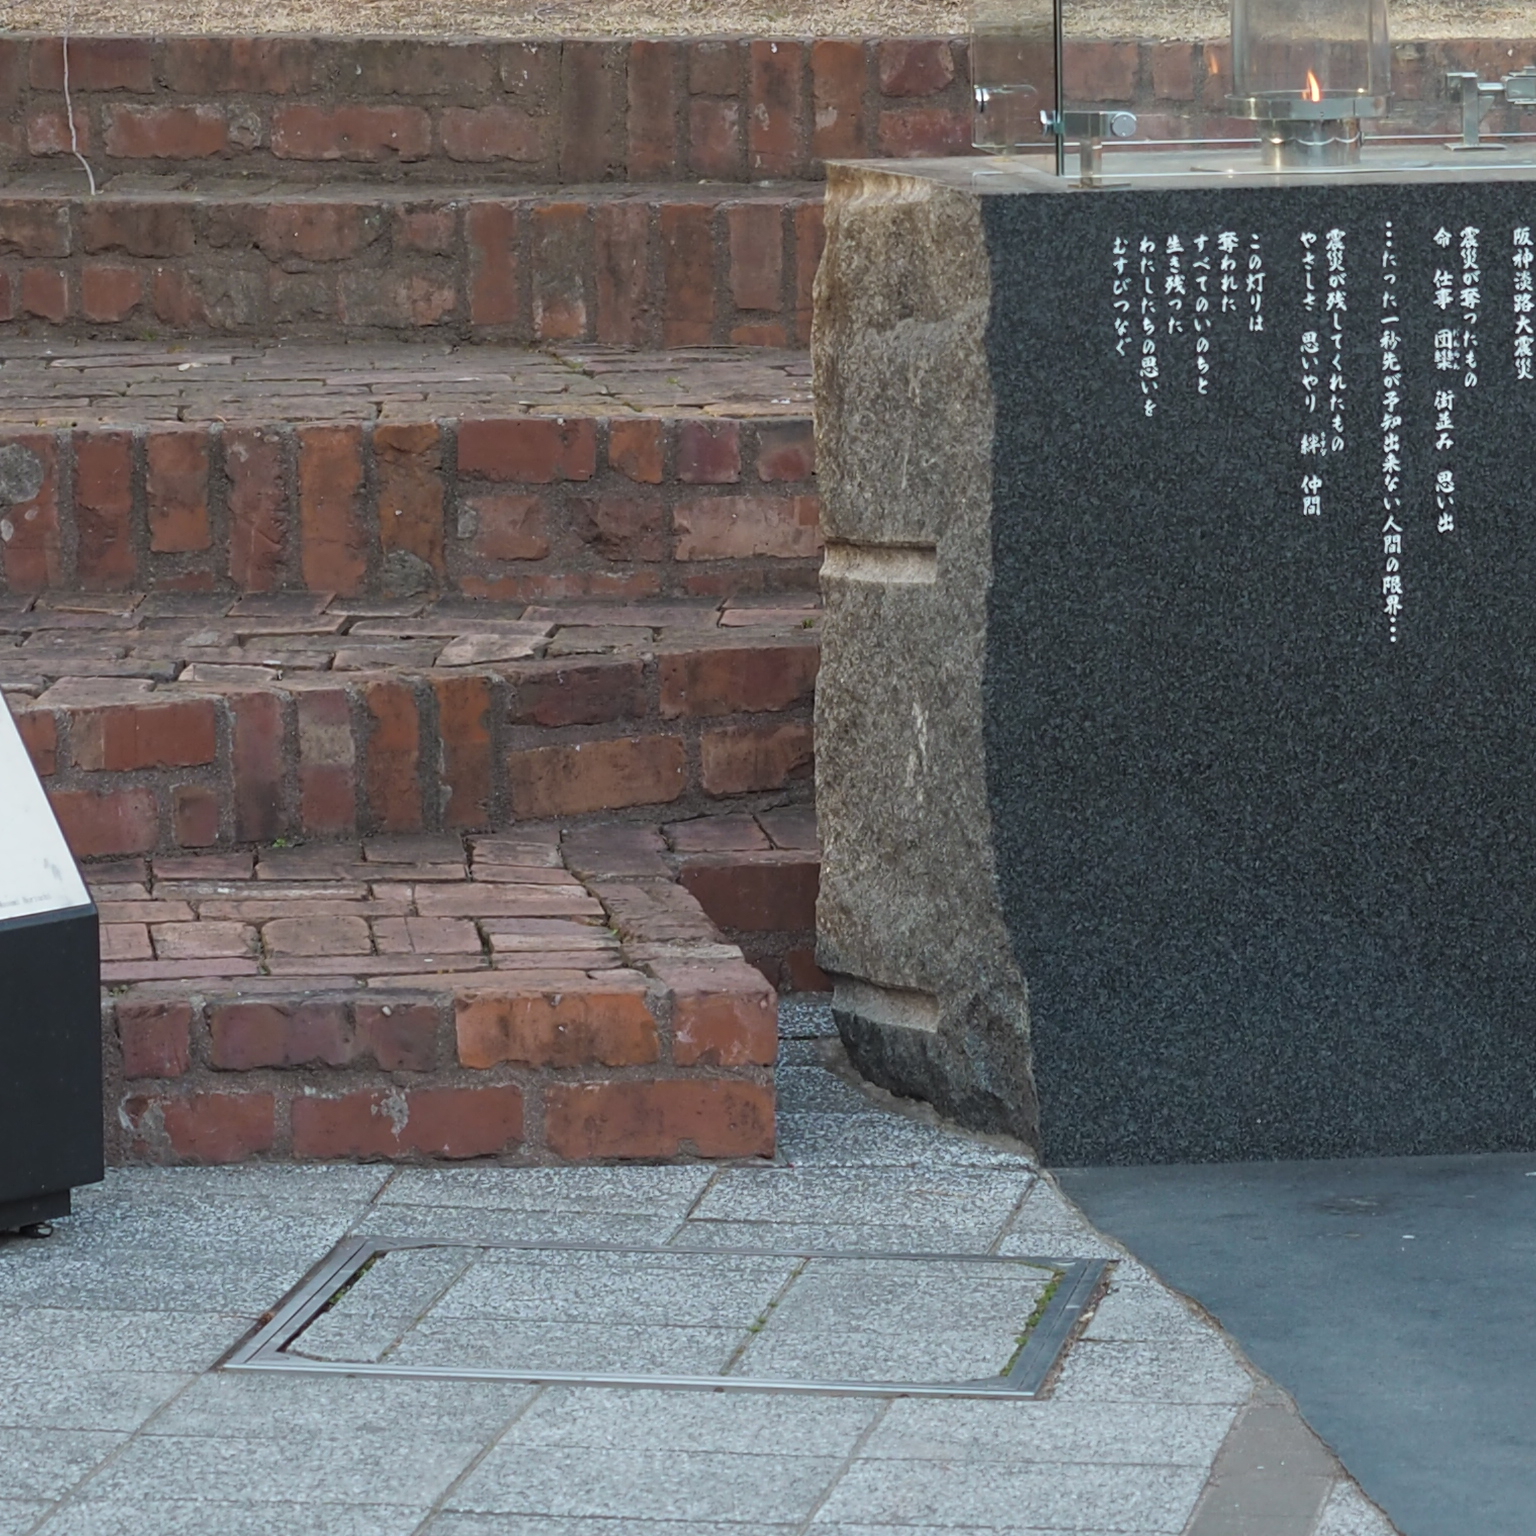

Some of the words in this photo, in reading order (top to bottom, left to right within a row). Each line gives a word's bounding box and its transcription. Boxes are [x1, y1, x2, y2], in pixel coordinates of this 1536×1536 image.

[1217, 231, 1239, 313] 奪われた
[1299, 231, 1317, 312] やさしさ
[1432, 226, 1453, 248] 命
[1112, 236, 1132, 357] むすびつなぐ
[1164, 234, 1186, 335] 生き残った
[1192, 233, 1212, 395] すべてのいのちと
[1245, 233, 1266, 332] この灯りは
[1432, 268, 1454, 310] 仕事
[1460, 225, 1482, 388] 震災が奪ったもの
[1511, 226, 1535, 380] 阪神淡路大震災
[1139, 235, 1159, 417] わたしたちの思いを
[1325, 228, 1348, 452] 震災が残してくれたもの
[1299, 330, 1320, 413] 思いやり
[1300, 433, 1320, 455] 絆
[1433, 389, 1456, 451] 街並み
[1300, 474, 1323, 516] 仲間
[1435, 470, 1455, 533] 思い出
